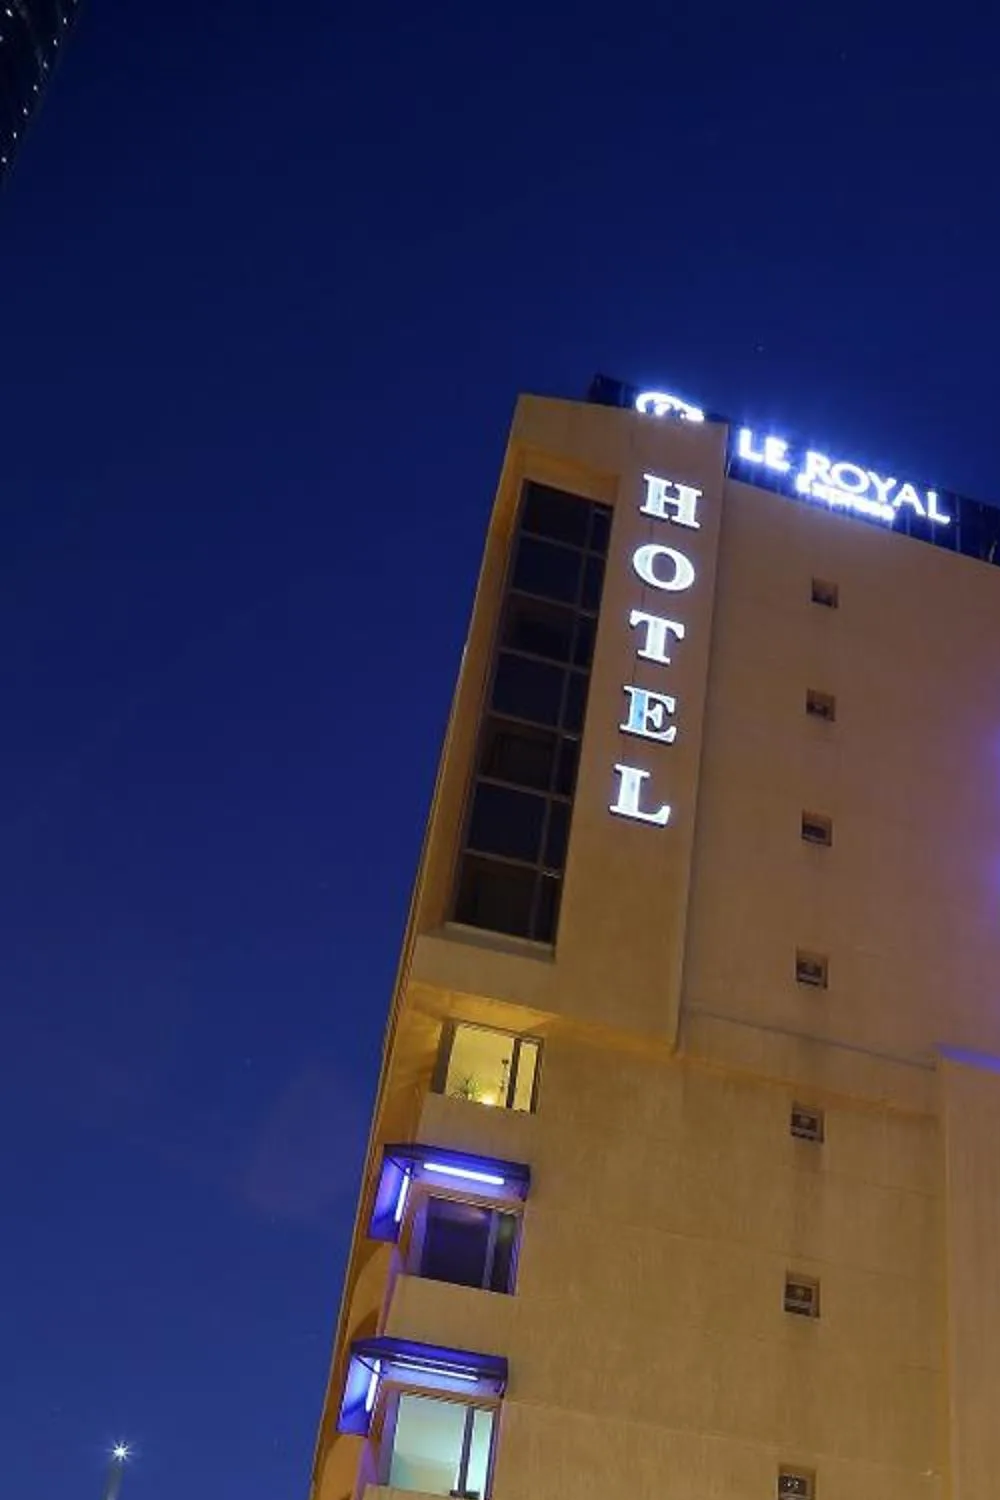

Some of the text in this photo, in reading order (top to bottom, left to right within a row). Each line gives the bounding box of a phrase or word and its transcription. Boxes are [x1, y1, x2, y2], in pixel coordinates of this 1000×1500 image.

[737, 427, 791, 472] LE
[804, 450, 951, 525] ROYAL
[608, 472, 703, 828] HOTEL
